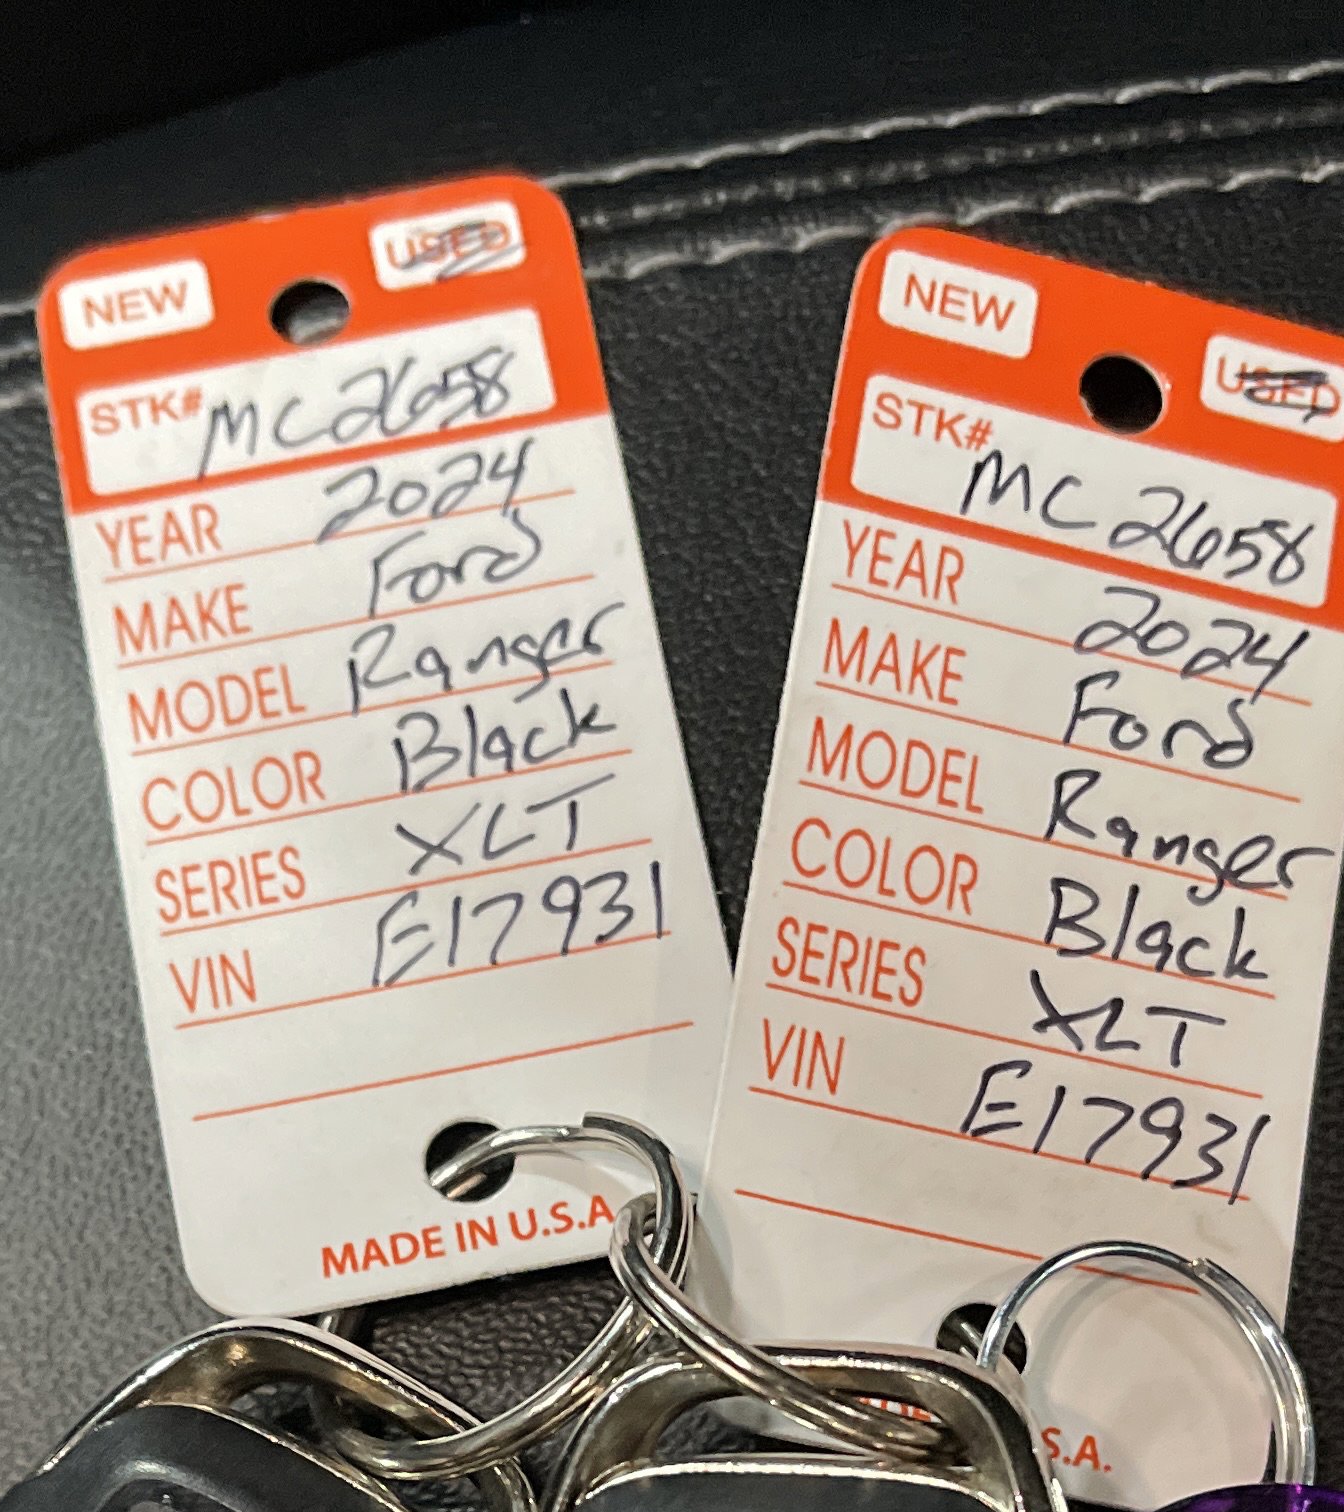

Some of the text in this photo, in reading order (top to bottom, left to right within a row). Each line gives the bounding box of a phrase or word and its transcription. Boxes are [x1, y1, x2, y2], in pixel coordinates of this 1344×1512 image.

[81, 279, 189, 329] NEW
[904, 272, 1015, 333] NEW
[90, 386, 203, 436] STK#
[196, 345, 515, 482] MC2658
[872, 390, 995, 452] STK#
[95, 502, 223, 569] YEAR
[315, 436, 535, 545] 2024
[367, 507, 543, 619] Ford
[843, 518, 966, 606] YEAR
[113, 582, 252, 656] MAKE
[346, 602, 626, 717] Ranger
[822, 616, 968, 705] MAKE
[1073, 584, 1312, 704] 2024
[127, 663, 307, 744] MODEL
[392, 687, 617, 794] Black
[1061, 670, 1254, 769] Ford
[141, 749, 327, 832] COLOR
[806, 715, 985, 815] MODEL
[395, 773, 616, 875] XLT
[790, 815, 979, 916] COLOR
[1043, 767, 1336, 904] Ranger
[154, 844, 306, 925] SERIES
[371, 860, 664, 988] E17931
[1043, 876, 1269, 980] Black
[169, 948, 258, 1014] VIN
[771, 914, 927, 1008] SERIES
[762, 1017, 846, 1096] VIN
[1029, 968, 1226, 1068] XLT
[958, 1059, 1272, 1206] E17931
[321, 1223, 446, 1280] MADE
[455, 1215, 499, 1253] IN
[1040, 1426, 1113, 1473] S.A.
